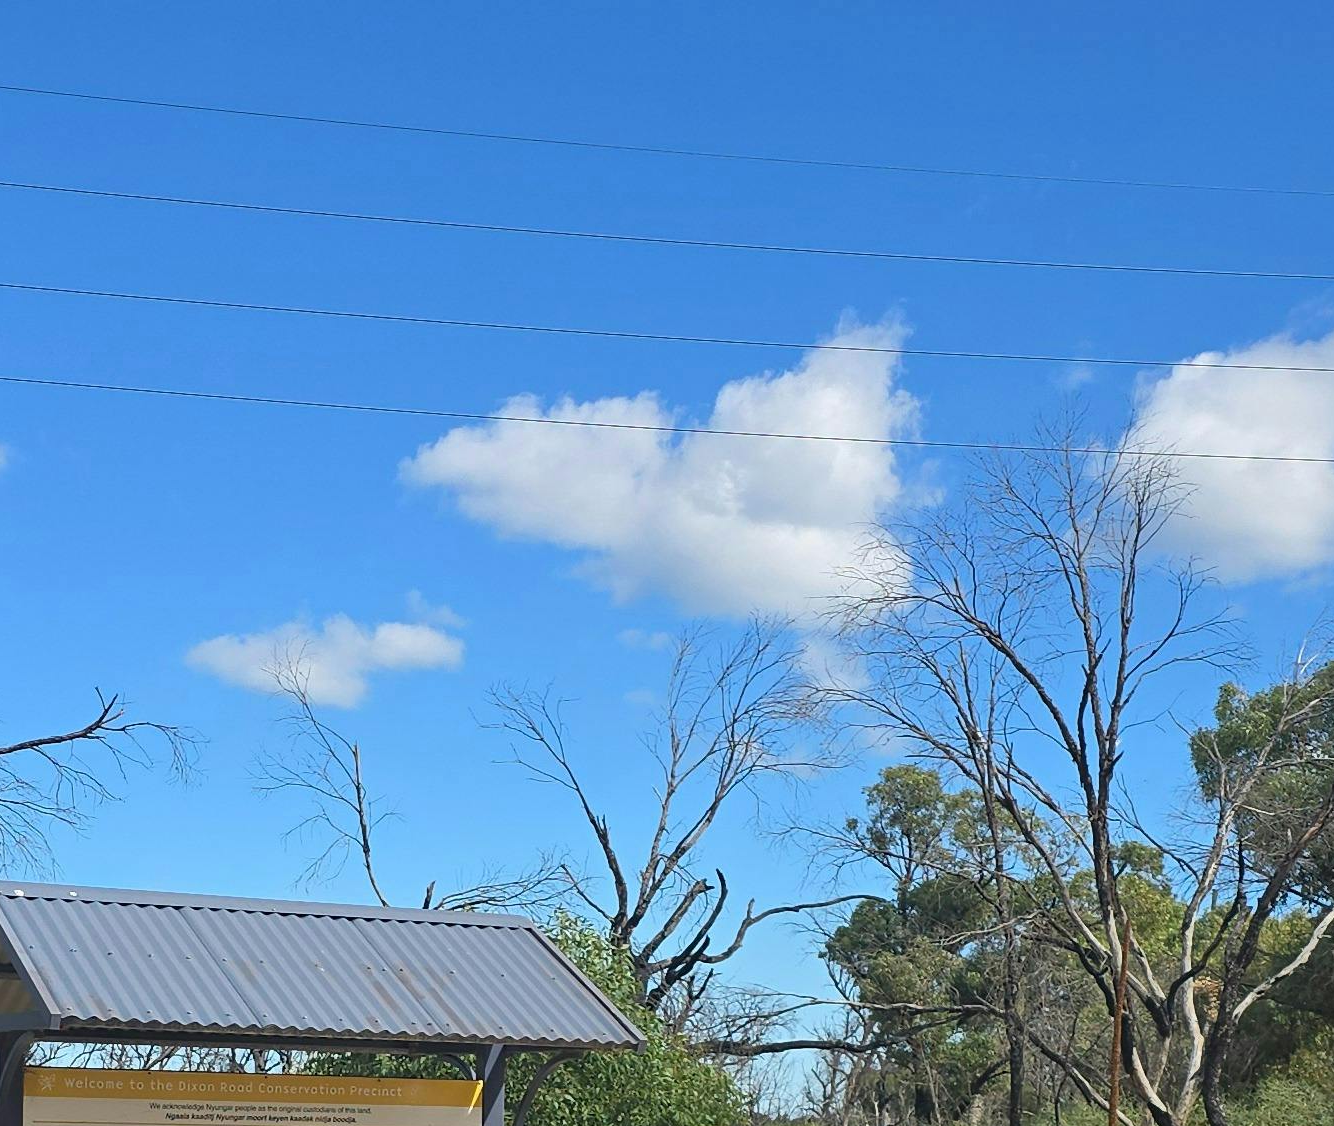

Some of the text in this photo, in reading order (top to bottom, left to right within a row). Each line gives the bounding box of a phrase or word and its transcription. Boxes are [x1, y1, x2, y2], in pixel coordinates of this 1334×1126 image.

[64, 1077, 402, 1097] Welcome to the Dixon Road Conservation Precinct
[149, 1102, 161, 1110] We
[162, 1103, 205, 1112] acknowledge
[206, 1103, 233, 1113] Nyungar
[235, 1104, 257, 1113] people
[279, 1105, 301, 1114] original
[216, 1113, 245, 1122] Nyungar
